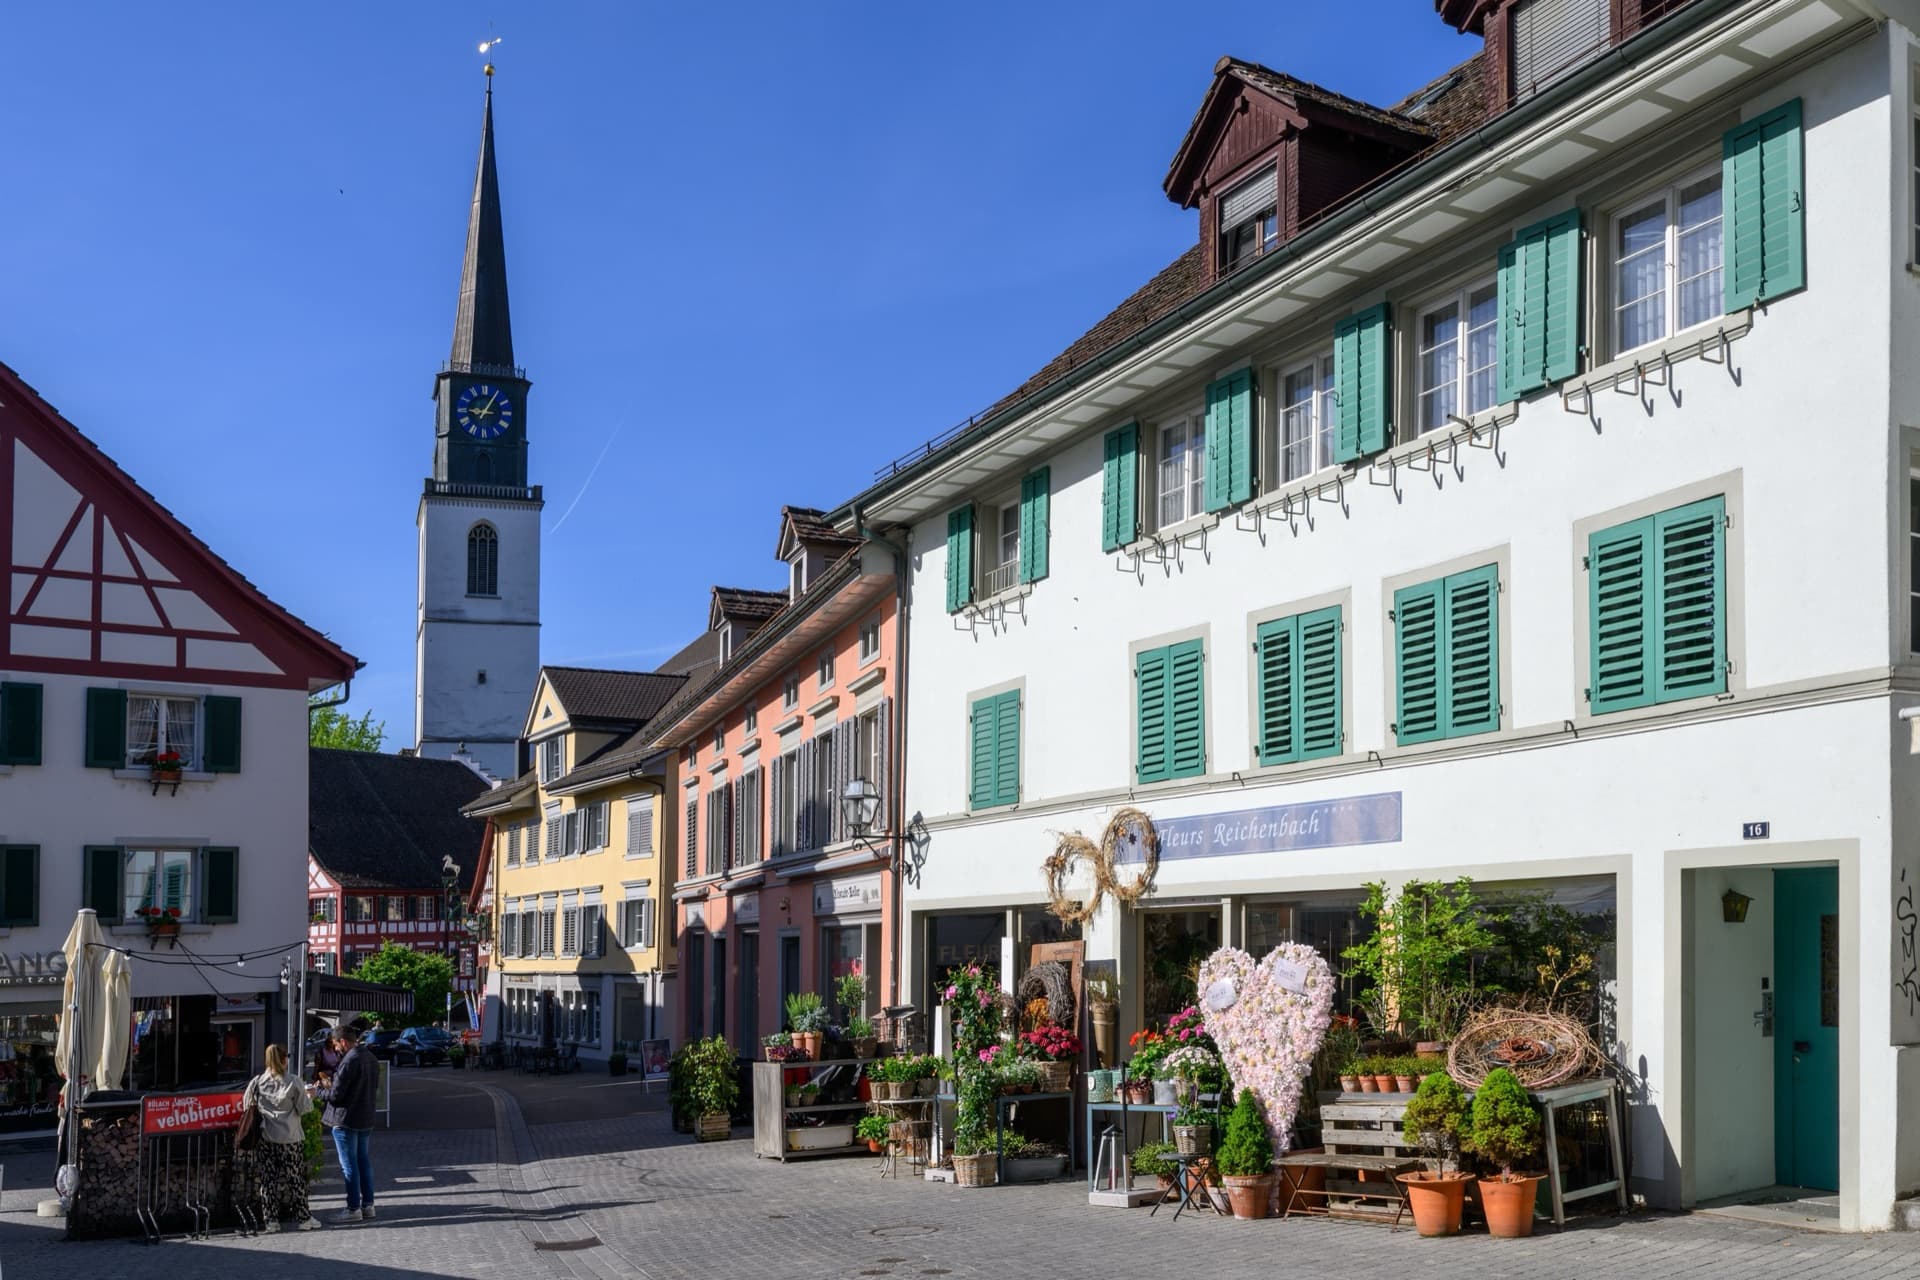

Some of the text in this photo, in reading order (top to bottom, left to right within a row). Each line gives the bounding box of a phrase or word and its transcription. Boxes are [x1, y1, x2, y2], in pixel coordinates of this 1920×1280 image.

[1158, 809, 1320, 847] Fleurs Reichenbach
[1748, 823, 1762, 837] 16
[157, 1102, 244, 1128] velobirrer.c
